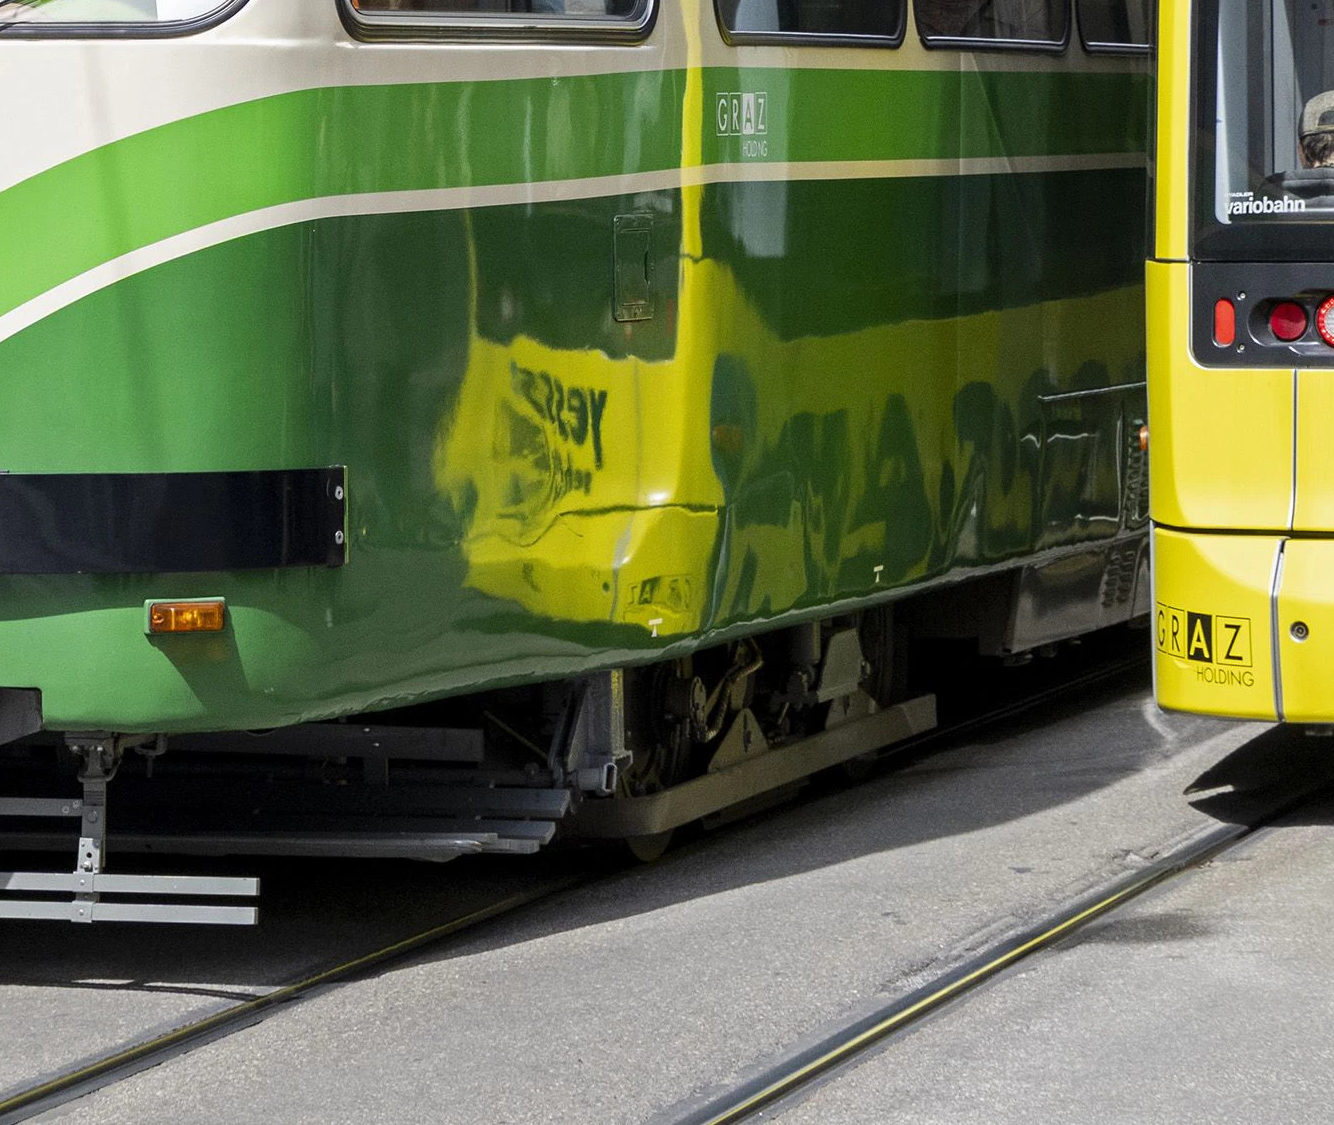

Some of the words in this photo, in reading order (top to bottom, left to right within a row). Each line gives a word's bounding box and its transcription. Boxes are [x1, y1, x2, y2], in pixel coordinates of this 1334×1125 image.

[717, 97, 766, 132] GRAZ
[1156, 609, 1244, 662] GRAZ
[1197, 666, 1255, 688] HOLDING
